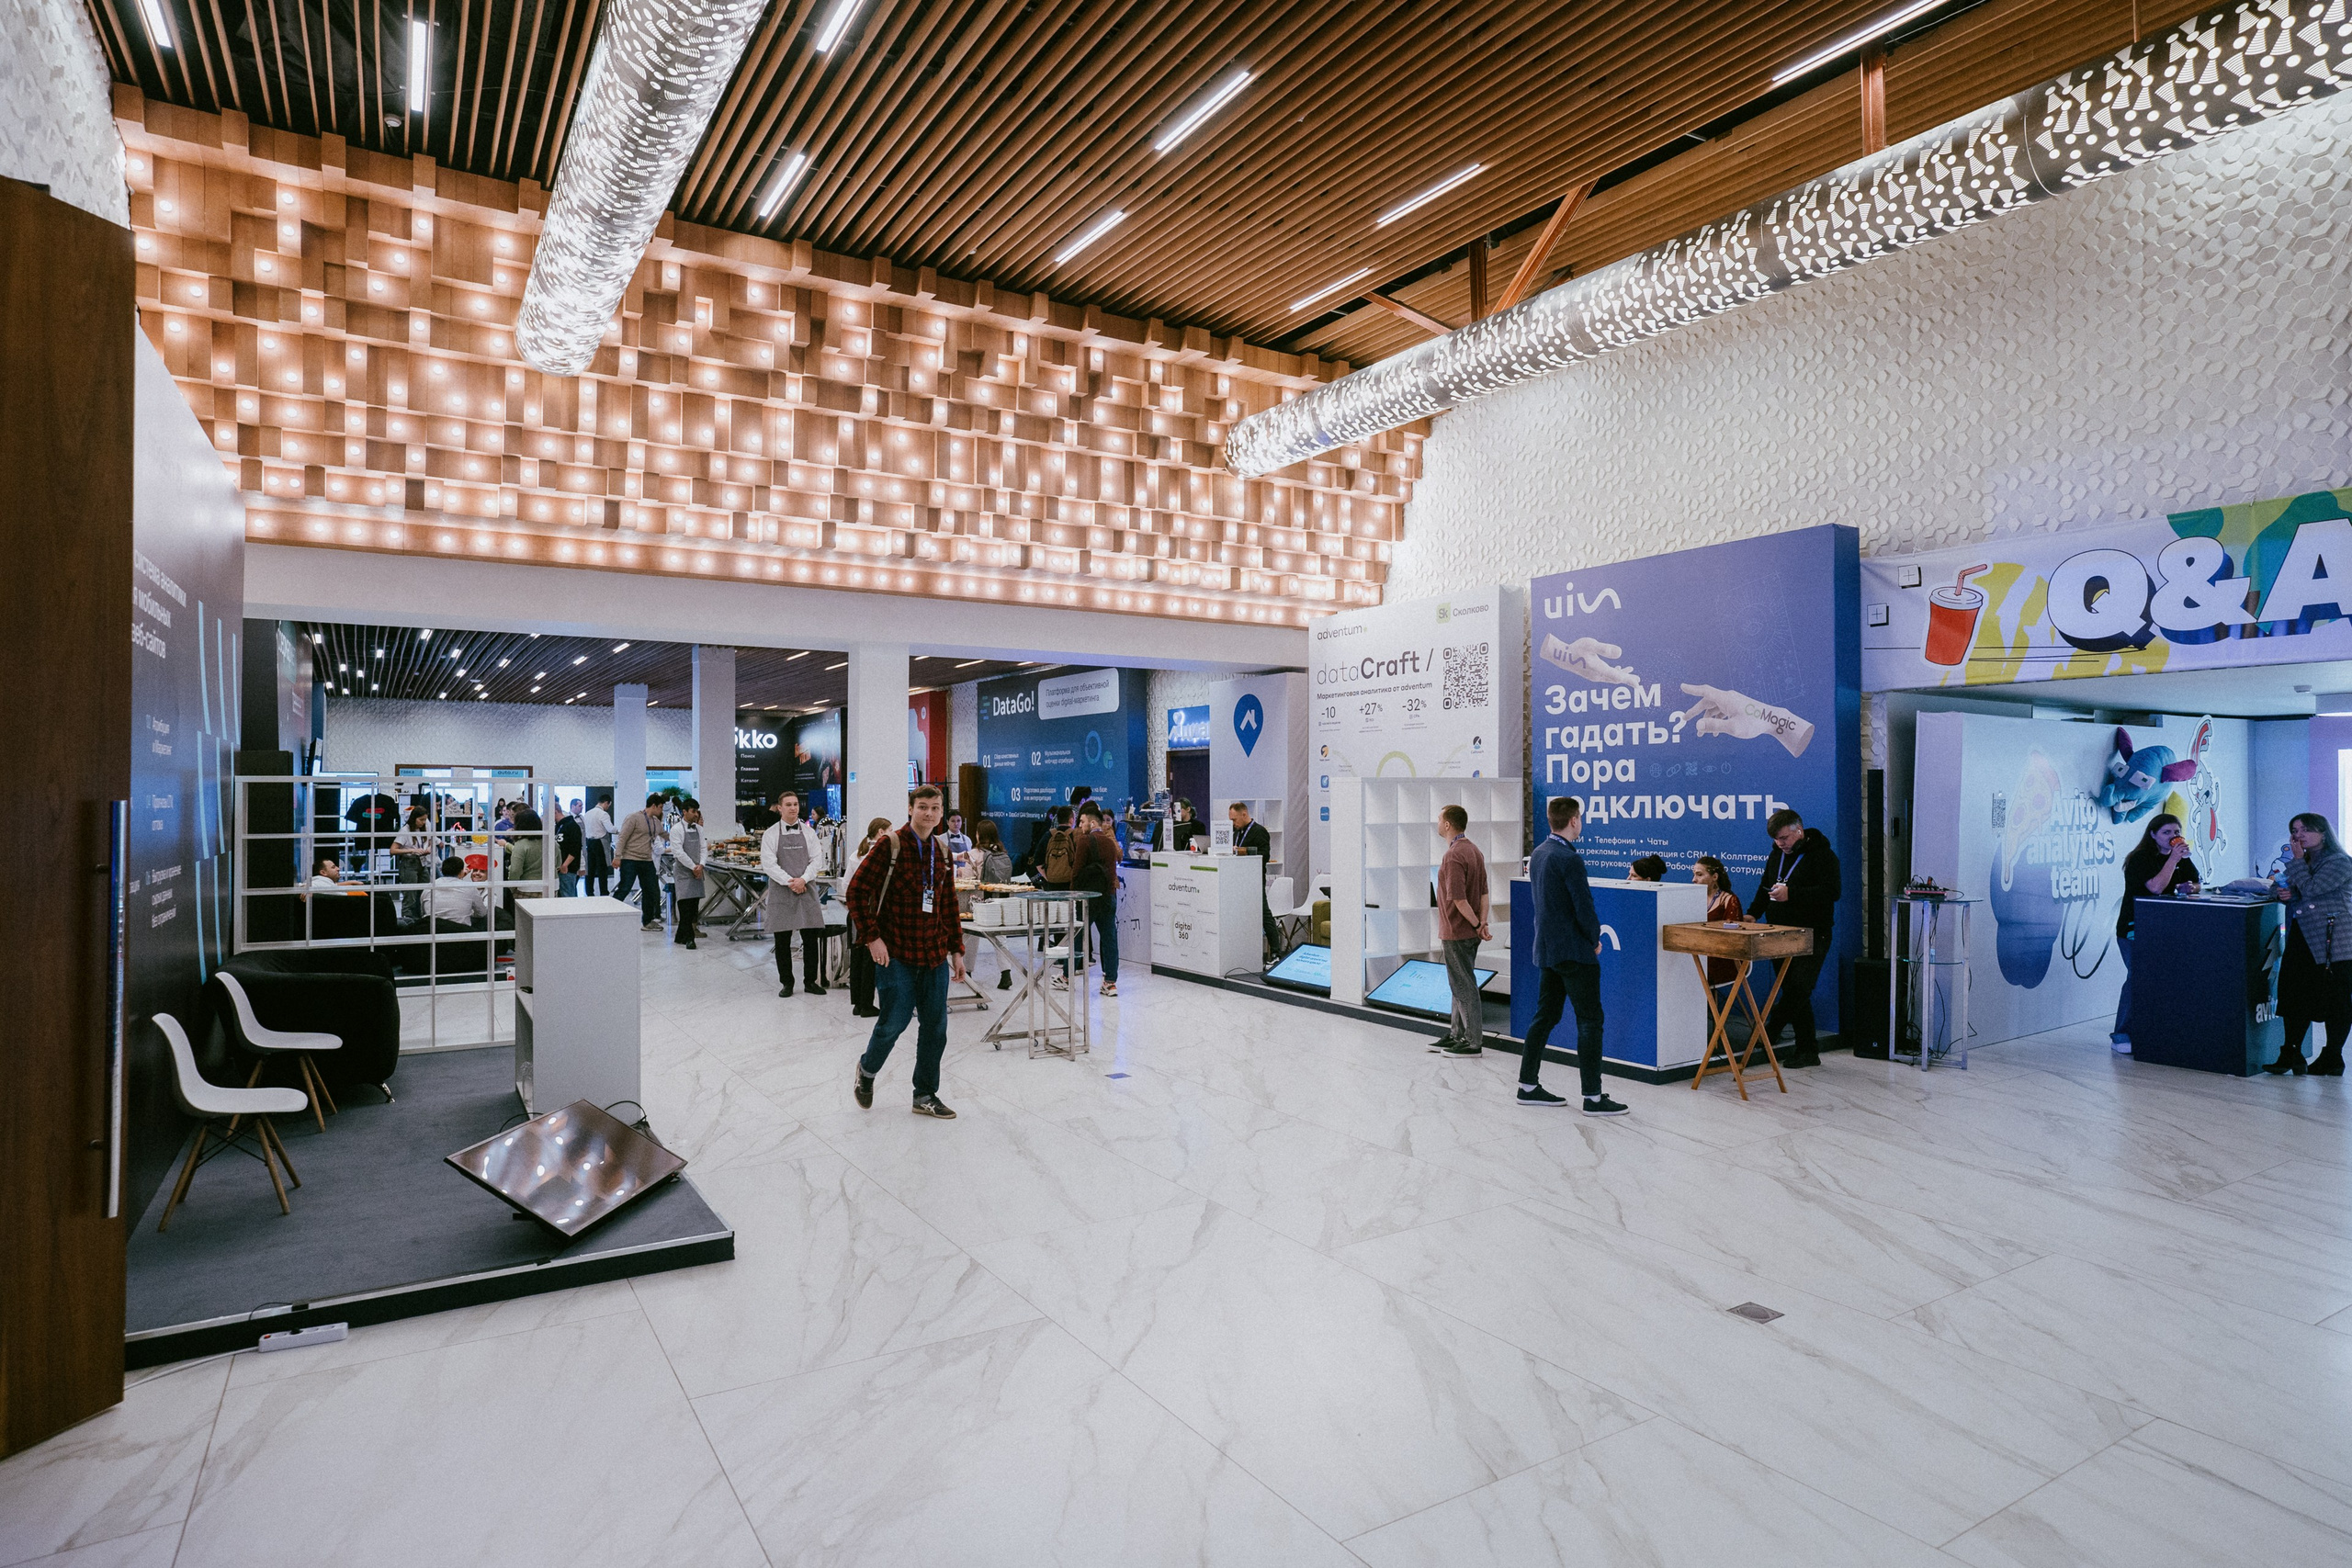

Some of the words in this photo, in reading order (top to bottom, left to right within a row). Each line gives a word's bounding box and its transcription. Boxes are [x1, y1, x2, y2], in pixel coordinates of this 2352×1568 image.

[2047, 517, 2352, 648] Q&A
[1438, 608, 1449, 619] Sk
[1453, 604, 1489, 617] Сколково
[1317, 650, 1420, 685] dataCraft
[1046, 687, 1070, 697] Платформа
[1079, 679, 1110, 693] объективной
[1317, 689, 1360, 700] Маркетинговая
[1361, 686, 1392, 696] аналитика
[1400, 682, 1432, 692] adventum
[992, 690, 1035, 716] DataGo!
[1402, 698, 1427, 712] -32%
[1544, 683, 1661, 715] Зачем
[1321, 706, 1337, 719] -10
[1359, 702, 1383, 716] +27%
[1745, 704, 1797, 734] CoMagic
[1545, 710, 1688, 753] гадать?
[982, 754, 991, 768] 01
[1031, 751, 1041, 766] 02
[1546, 753, 1635, 790] Пора
[1011, 787, 1021, 802] 03
[1546, 793, 1790, 824] одключать
[2050, 787, 2098, 830] Avito
[1595, 836, 1635, 846] Телефония
[1646, 837, 1668, 846] Чаты
[2026, 823, 2115, 868] analytics
[1587, 849, 1620, 858] рекламы
[1630, 849, 1679, 858] Интеграция
[1687, 851, 1708, 859] CRM
[1721, 852, 1770, 862] Коллтреки
[1601, 860, 1633, 869] руковод
[1666, 862, 1695, 871] Рабоче
[2051, 865, 2099, 902] team
[1174, 921, 1193, 931] digital
[1178, 931, 1189, 940] 360
[2256, 995, 2278, 1023] avit
